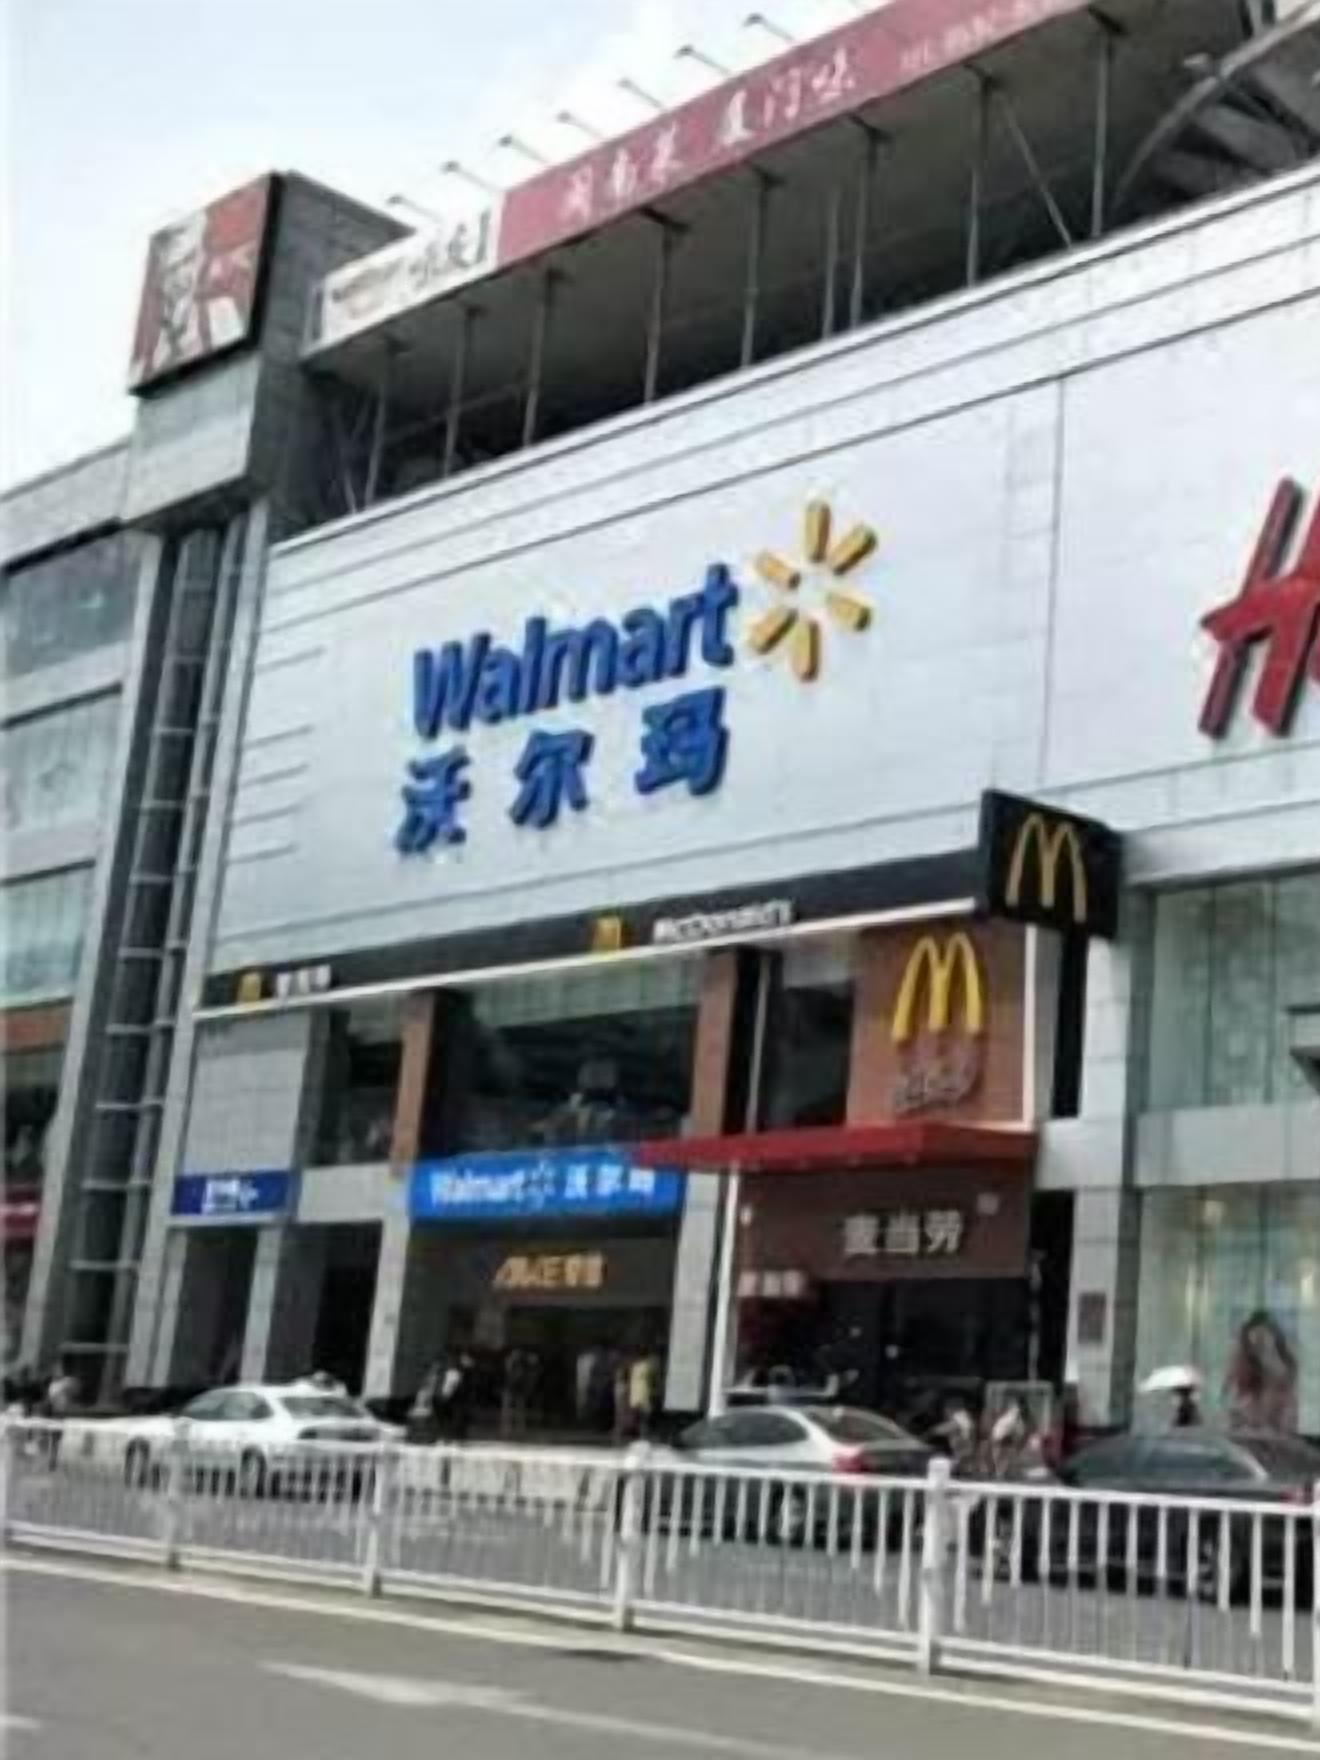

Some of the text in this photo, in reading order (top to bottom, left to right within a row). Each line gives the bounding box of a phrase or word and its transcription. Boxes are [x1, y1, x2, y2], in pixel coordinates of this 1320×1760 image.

[412, 561, 740, 740] Walmart
[394, 685, 731, 856] 沃尔玛
[429, 1165, 528, 1205] Walmart
[842, 1208, 963, 1257] 麦当劳
